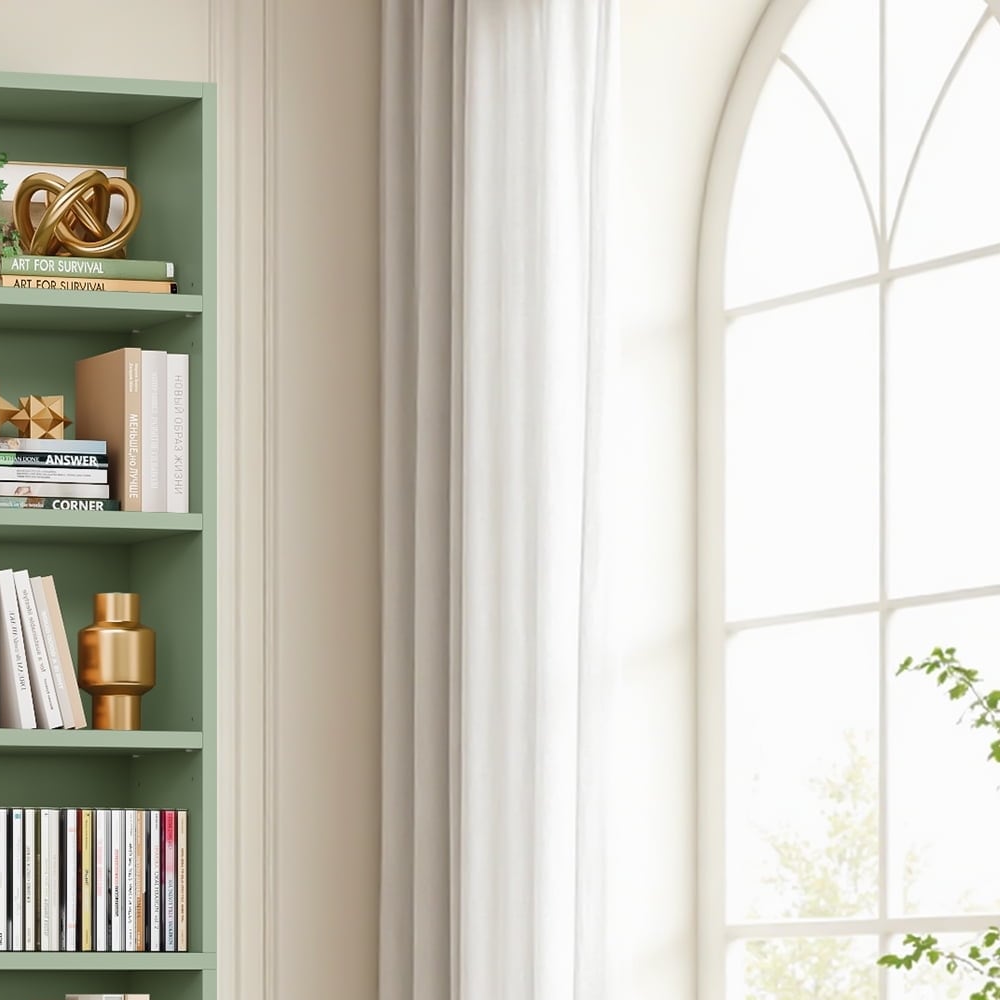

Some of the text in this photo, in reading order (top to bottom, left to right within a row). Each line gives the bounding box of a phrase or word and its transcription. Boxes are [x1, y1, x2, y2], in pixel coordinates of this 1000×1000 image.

[11, 258, 104, 273] ART FOR SURVIVAL
[14, 279, 105, 291] ART FOR SURVIVAL
[174, 375, 184, 495] НОВЫЙ ОБРАЗ ЖИЗНИ
[45, 455, 99, 467] ANSWER
[52, 500, 104, 511] CORNER
